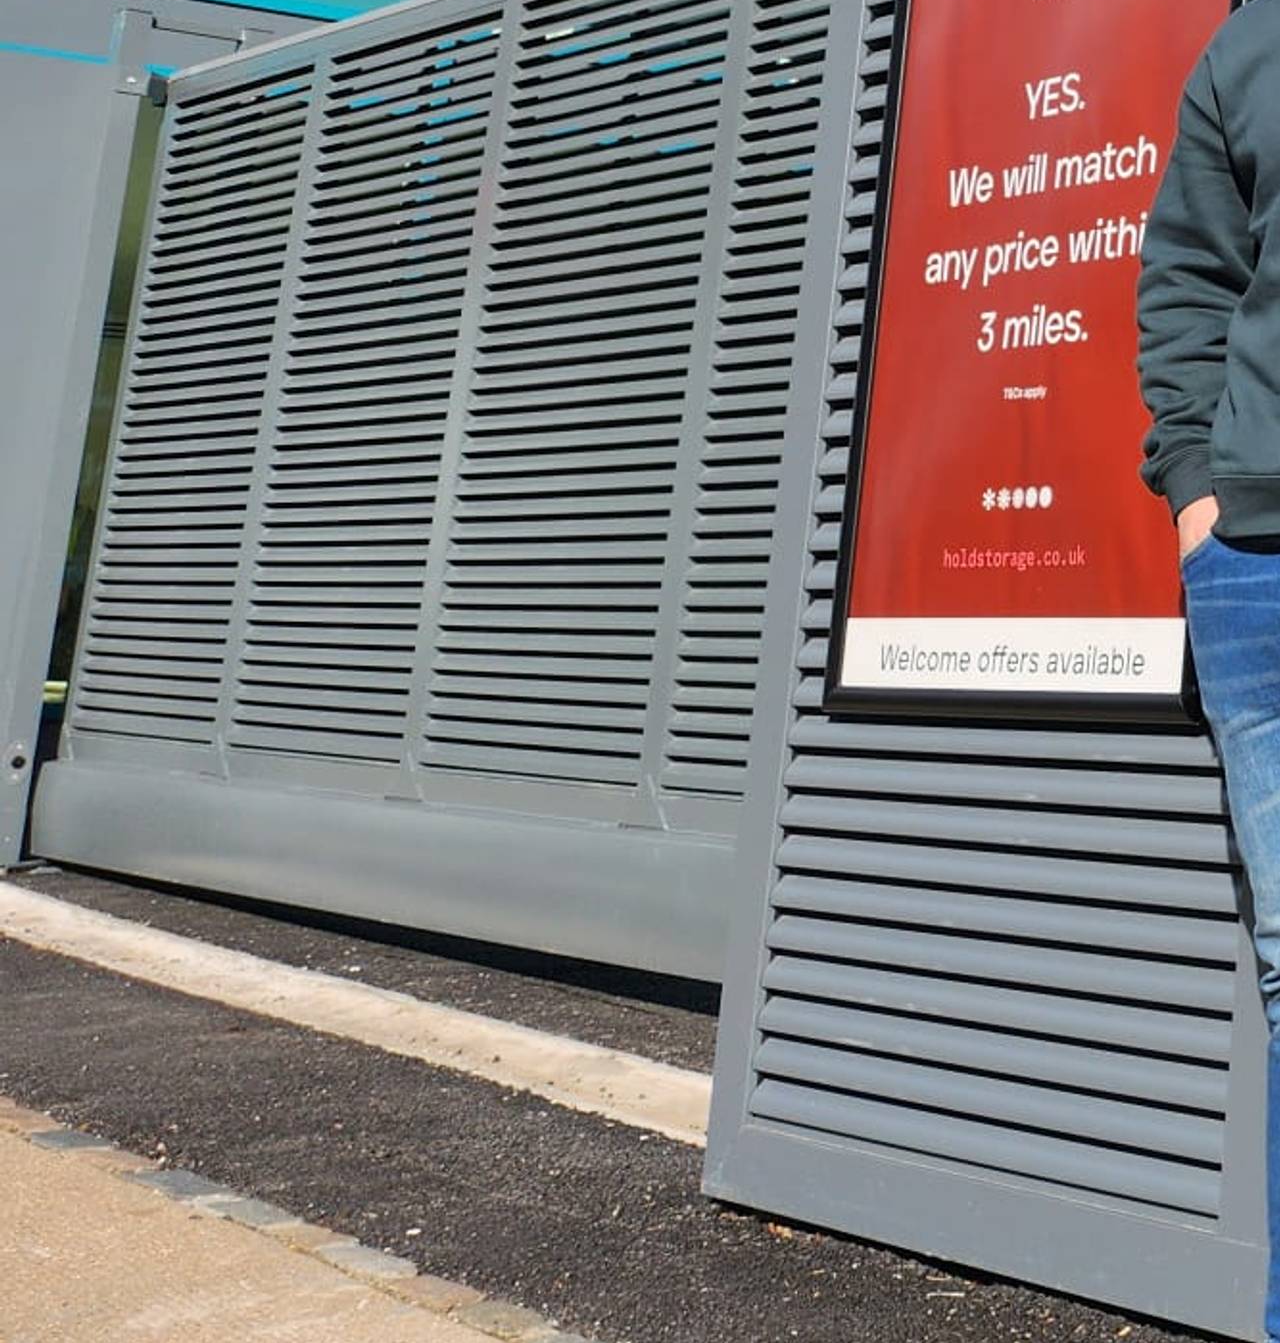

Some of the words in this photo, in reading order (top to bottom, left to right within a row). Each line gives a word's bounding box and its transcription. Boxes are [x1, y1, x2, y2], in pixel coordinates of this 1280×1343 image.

[1025, 72, 1086, 120] YES.
[949, 165, 994, 208] We
[1003, 152, 1048, 199] will
[1054, 135, 1158, 190] match
[924, 248, 978, 290] any
[982, 230, 1060, 287] price
[1068, 211, 1149, 264] withi
[976, 311, 997, 353] 3
[1002, 304, 1089, 350] miles.
[943, 545, 1086, 571] holdstorage.co.uk
[880, 643, 971, 673] Welcome
[978, 645, 1040, 675] offers
[1046, 644, 1146, 676] available
